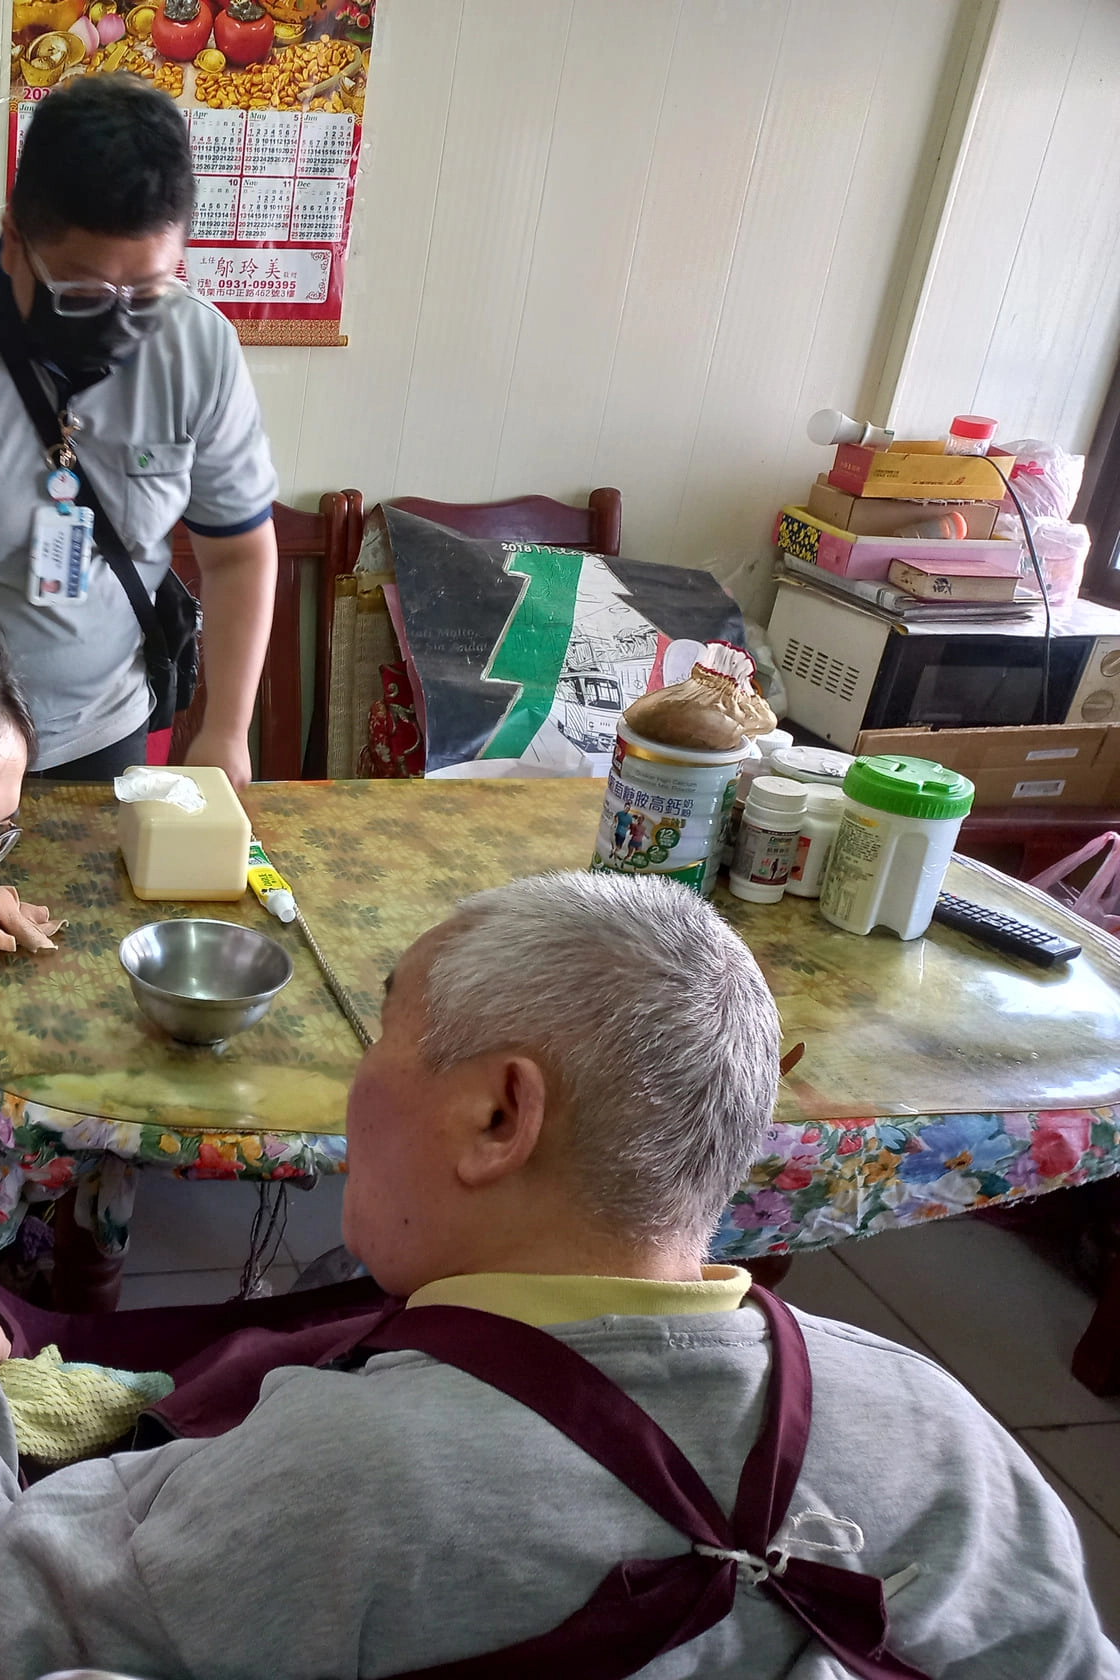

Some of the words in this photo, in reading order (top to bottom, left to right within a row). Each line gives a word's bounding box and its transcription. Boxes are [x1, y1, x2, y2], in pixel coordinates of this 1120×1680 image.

[347, 116, 353, 124] 6
[218, 279, 297, 289] 0931-099395
[501, 542, 532, 553] 2018
